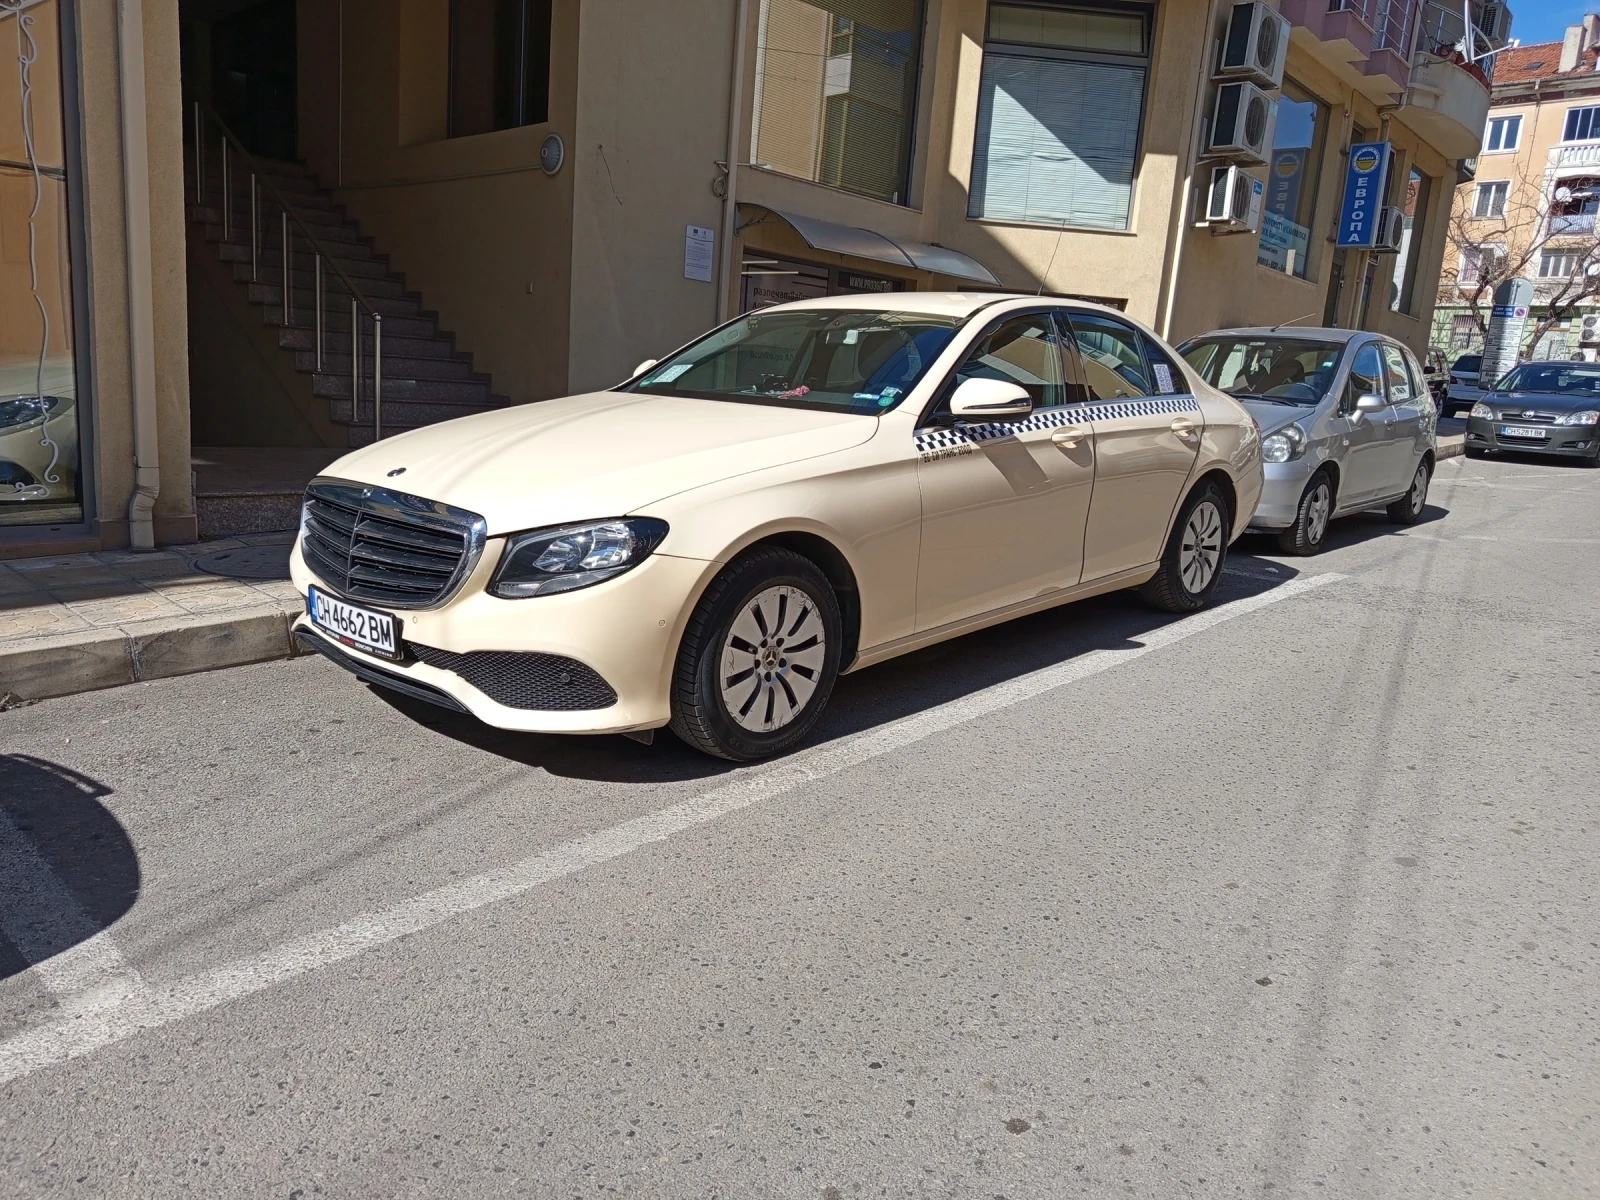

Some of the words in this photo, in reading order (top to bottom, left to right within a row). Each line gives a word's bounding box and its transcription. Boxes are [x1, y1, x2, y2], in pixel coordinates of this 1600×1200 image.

[1347, 177, 1368, 242] ЕВРОПА
[753, 287, 812, 300] разпечатвай
[1506, 428, 1544, 437] CH5281BK
[316, 595, 393, 648] CH4662BM
